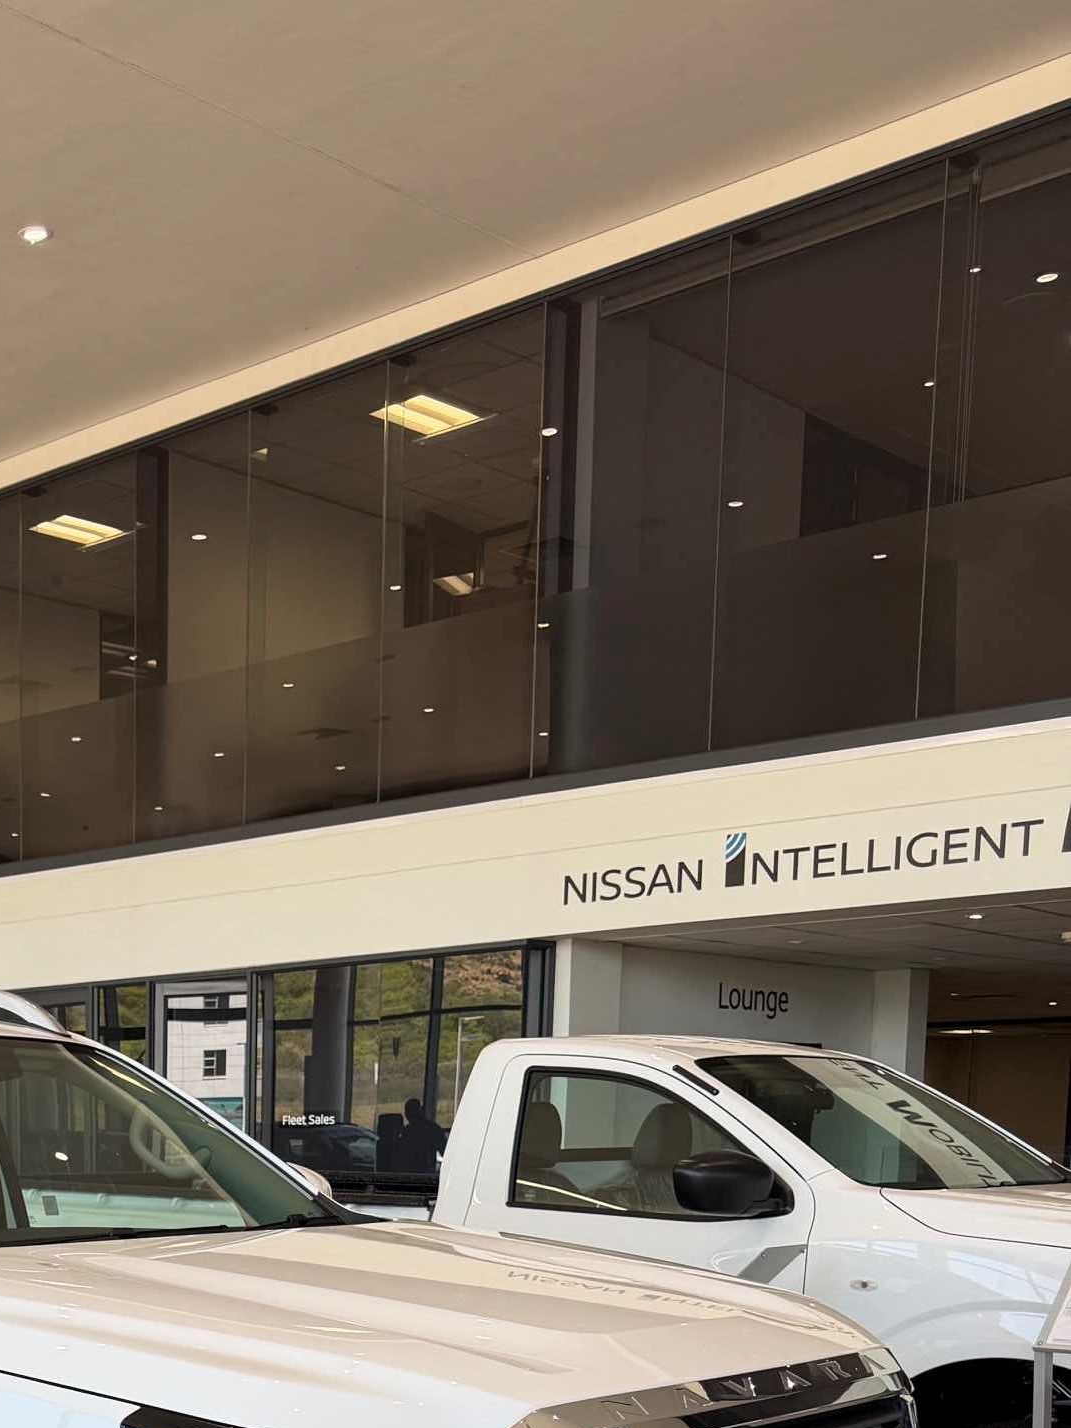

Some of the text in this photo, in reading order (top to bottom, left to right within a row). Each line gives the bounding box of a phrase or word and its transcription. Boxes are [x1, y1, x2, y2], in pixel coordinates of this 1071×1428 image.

[563, 859, 704, 905] NISSAN
[718, 982, 789, 1019] Lounge
[282, 1113, 336, 1126] Fleet Sales
